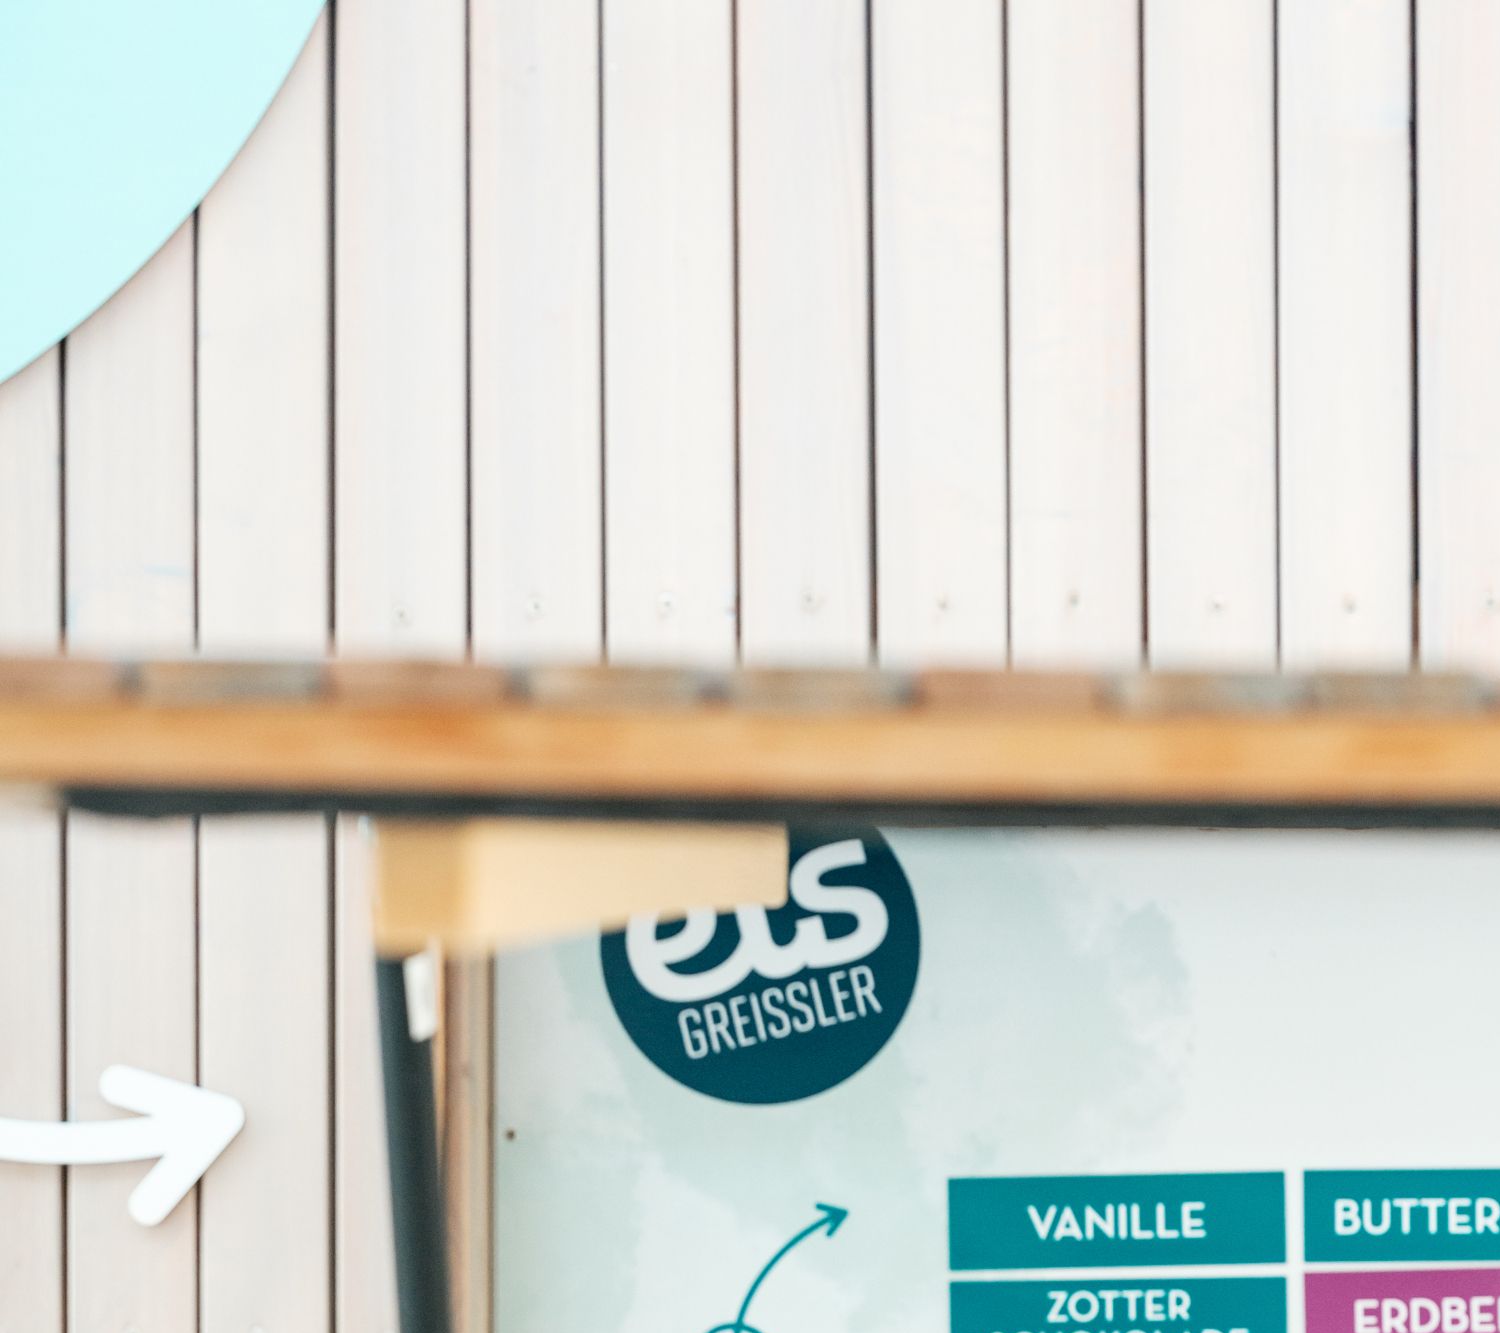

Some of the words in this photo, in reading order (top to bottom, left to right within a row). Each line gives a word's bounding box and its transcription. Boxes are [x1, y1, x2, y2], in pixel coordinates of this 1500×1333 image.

[677, 964, 882, 1060] GREISSLER
[1028, 1201, 1207, 1241] VANILLE
[1046, 1289, 1191, 1323] ZOTTER
